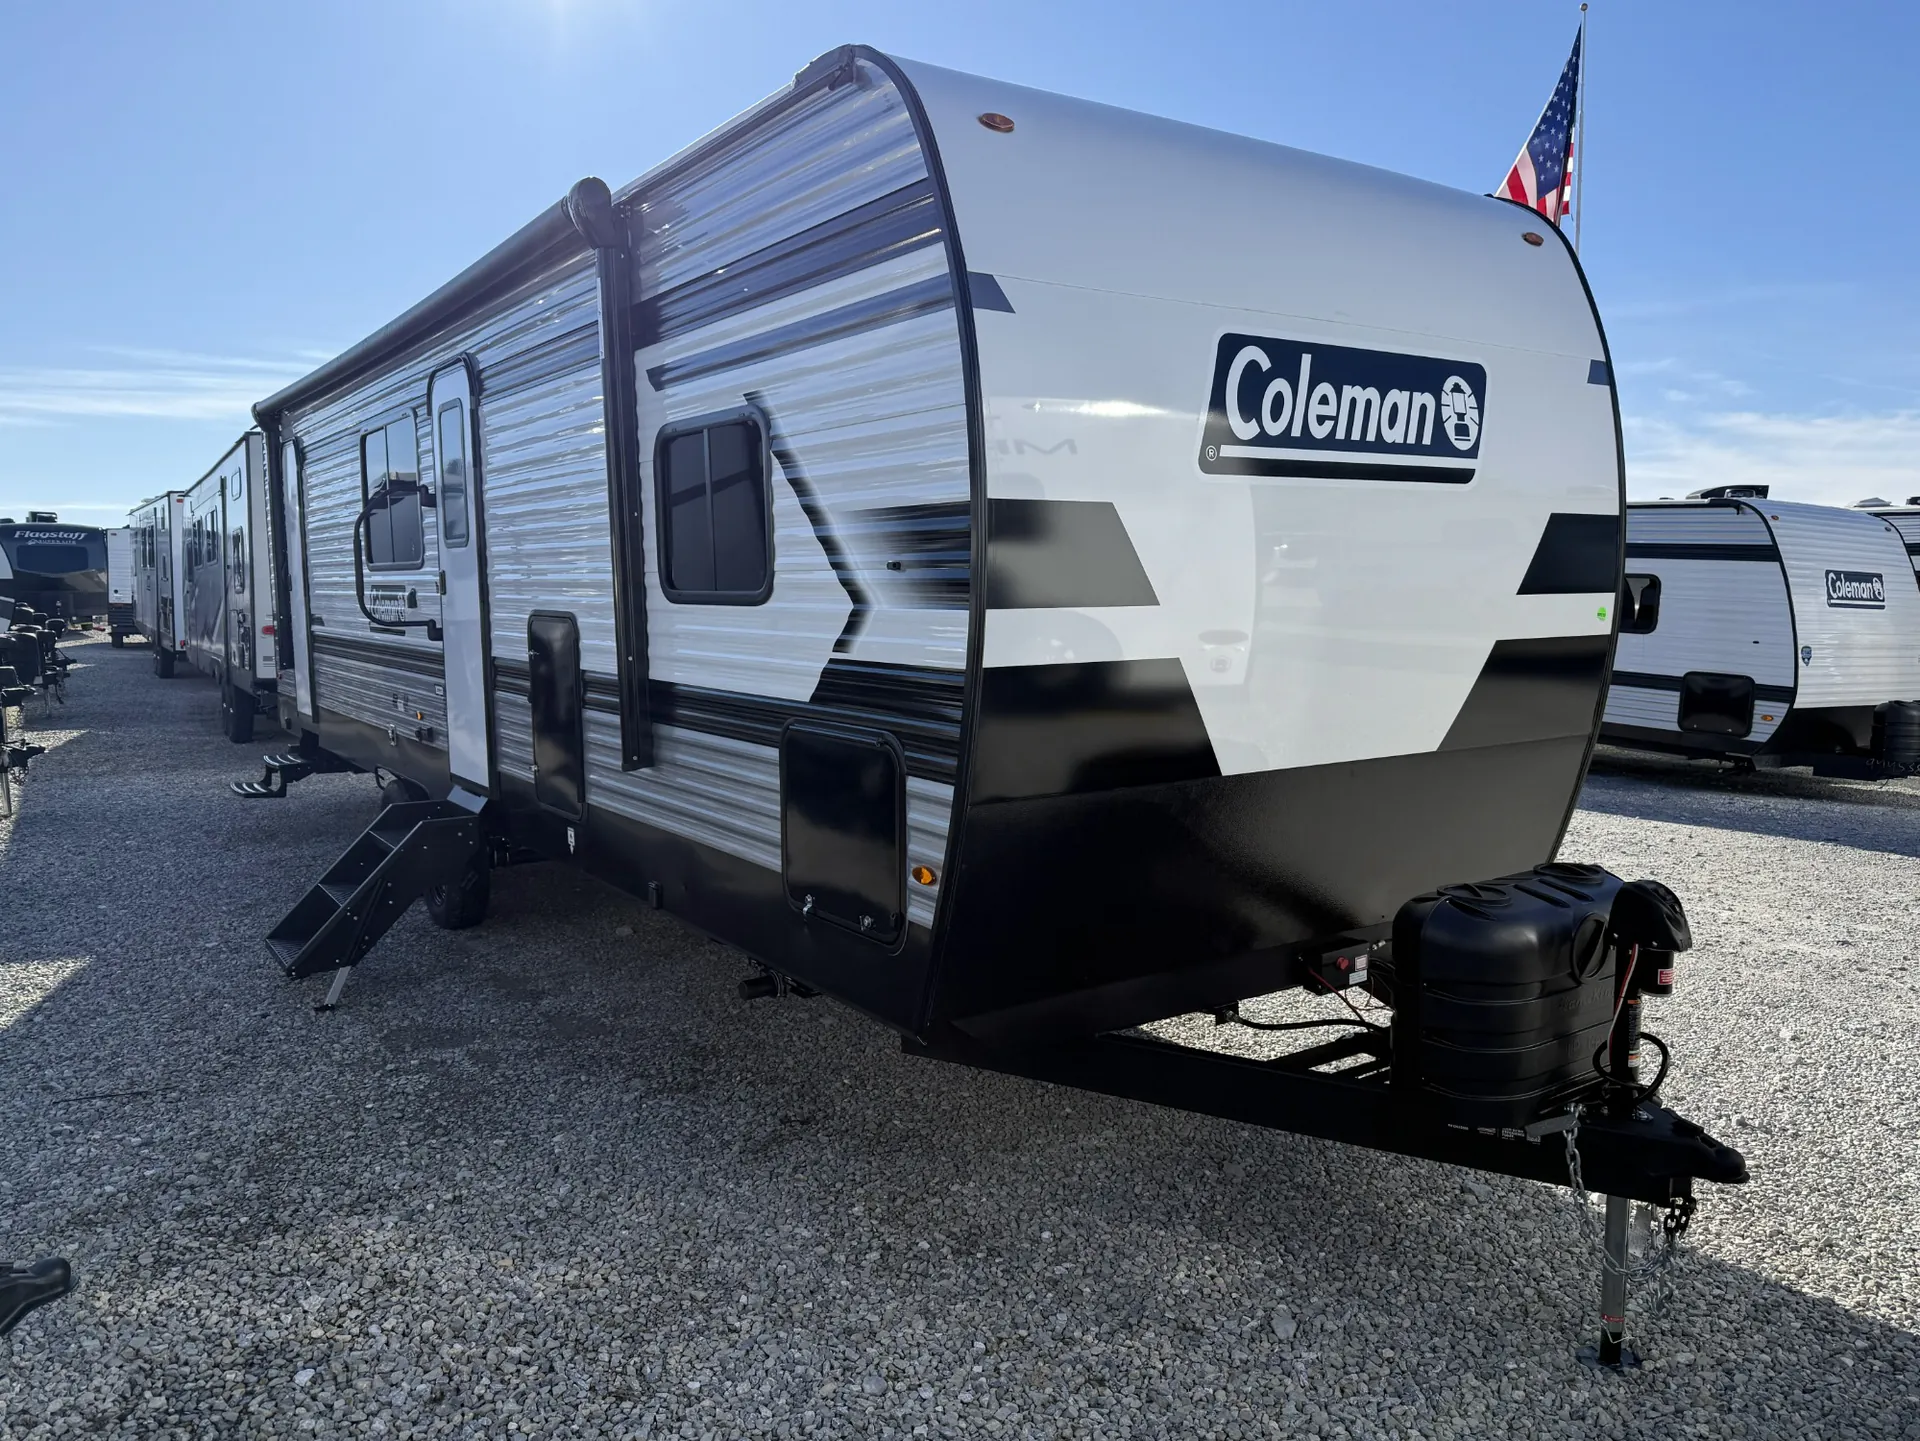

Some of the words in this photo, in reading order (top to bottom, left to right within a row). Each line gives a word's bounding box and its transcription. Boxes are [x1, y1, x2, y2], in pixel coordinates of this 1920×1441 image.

[1225, 345, 1436, 447] Coleman
[14, 530, 88, 540] Flagstaff
[1828, 572, 1874, 599] Coleman
